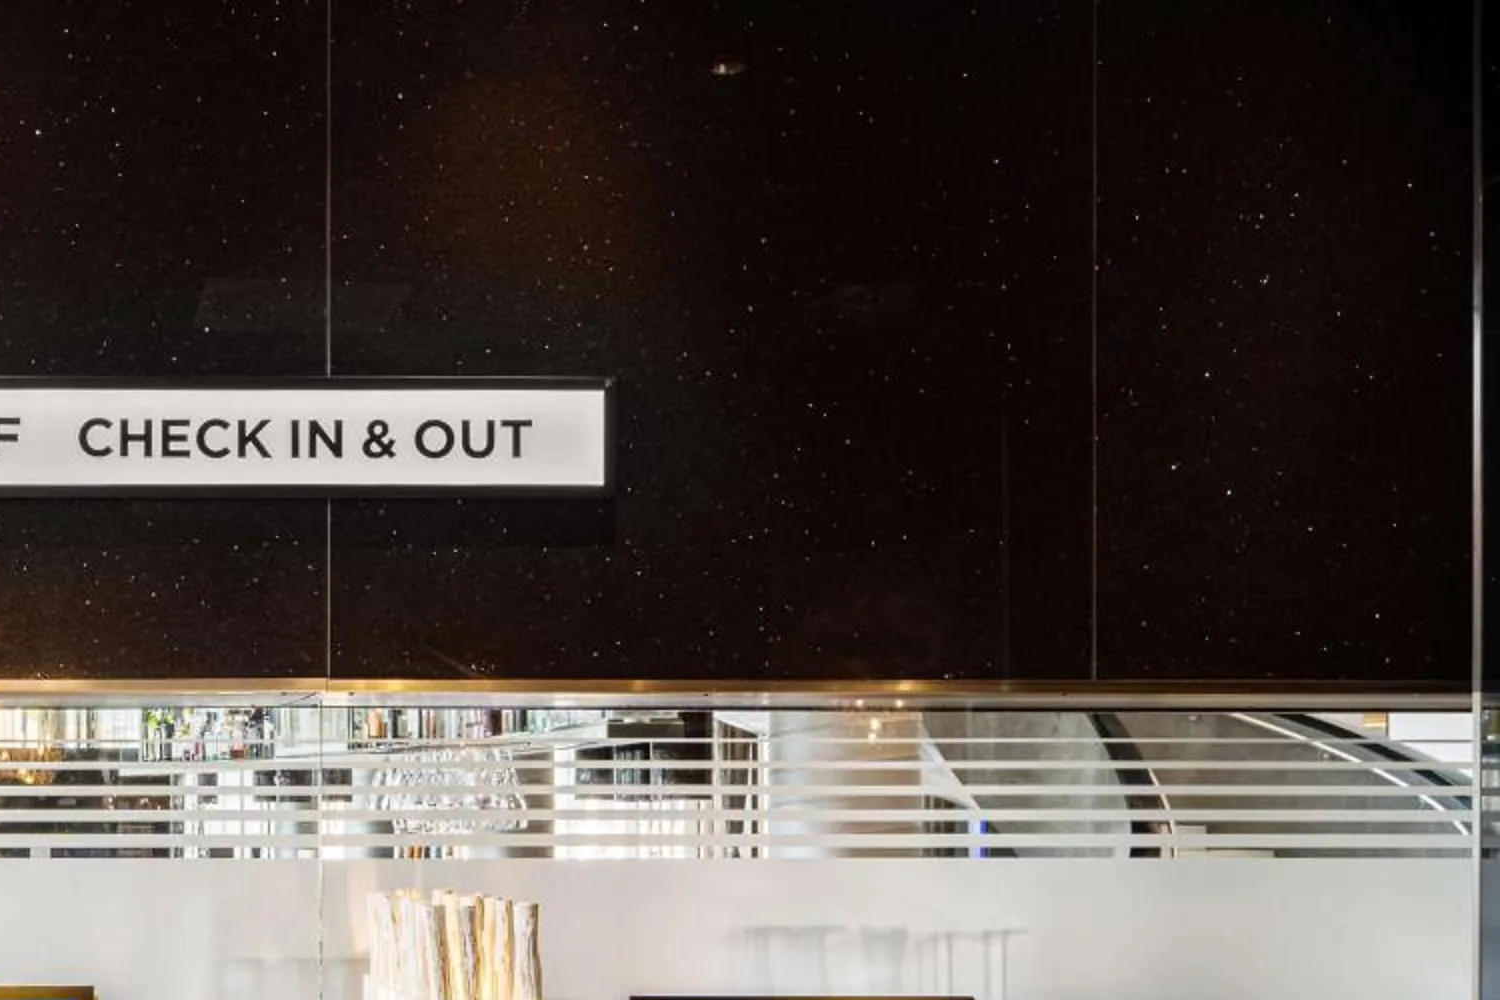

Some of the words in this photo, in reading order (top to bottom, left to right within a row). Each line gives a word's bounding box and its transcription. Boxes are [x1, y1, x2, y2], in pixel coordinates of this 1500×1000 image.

[77, 417, 273, 459] CHECK
[290, 419, 343, 459] IN
[361, 419, 397, 459] &
[414, 419, 533, 459] OUT
